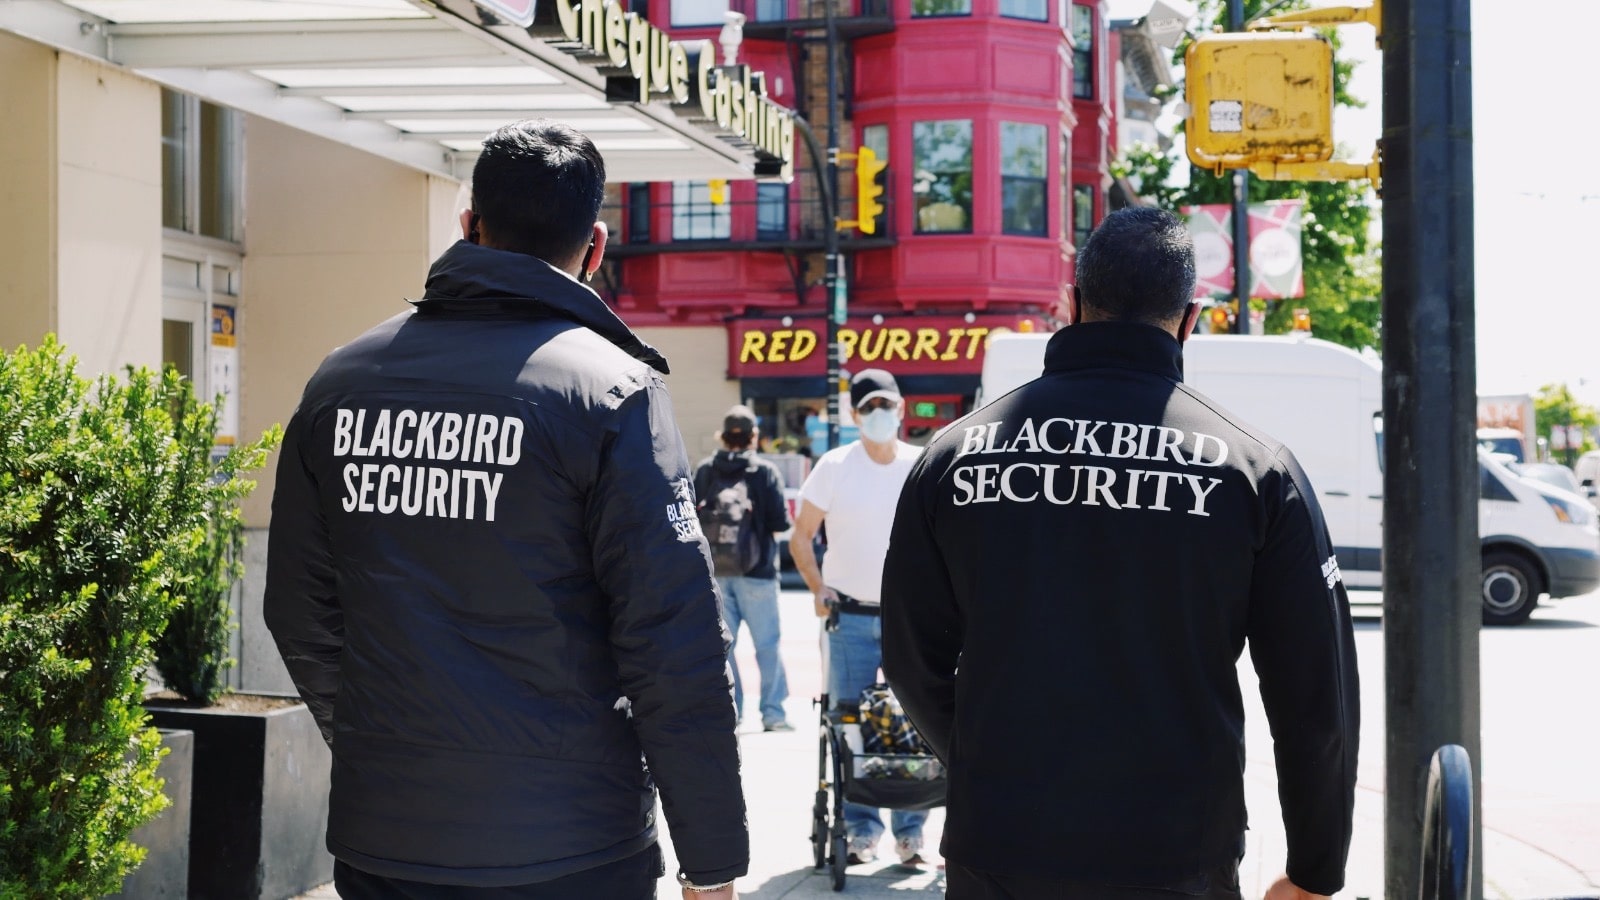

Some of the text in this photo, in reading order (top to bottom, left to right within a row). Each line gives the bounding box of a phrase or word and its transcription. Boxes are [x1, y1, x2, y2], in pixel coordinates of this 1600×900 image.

[698, 39, 795, 184] Cashing
[740, 330, 817, 363] RED
[333, 408, 525, 466] BLACKBIRD
[956, 417, 1229, 468] BLACKBIRD
[342, 462, 503, 522] SECURITY
[953, 463, 1222, 517] SECURITY
